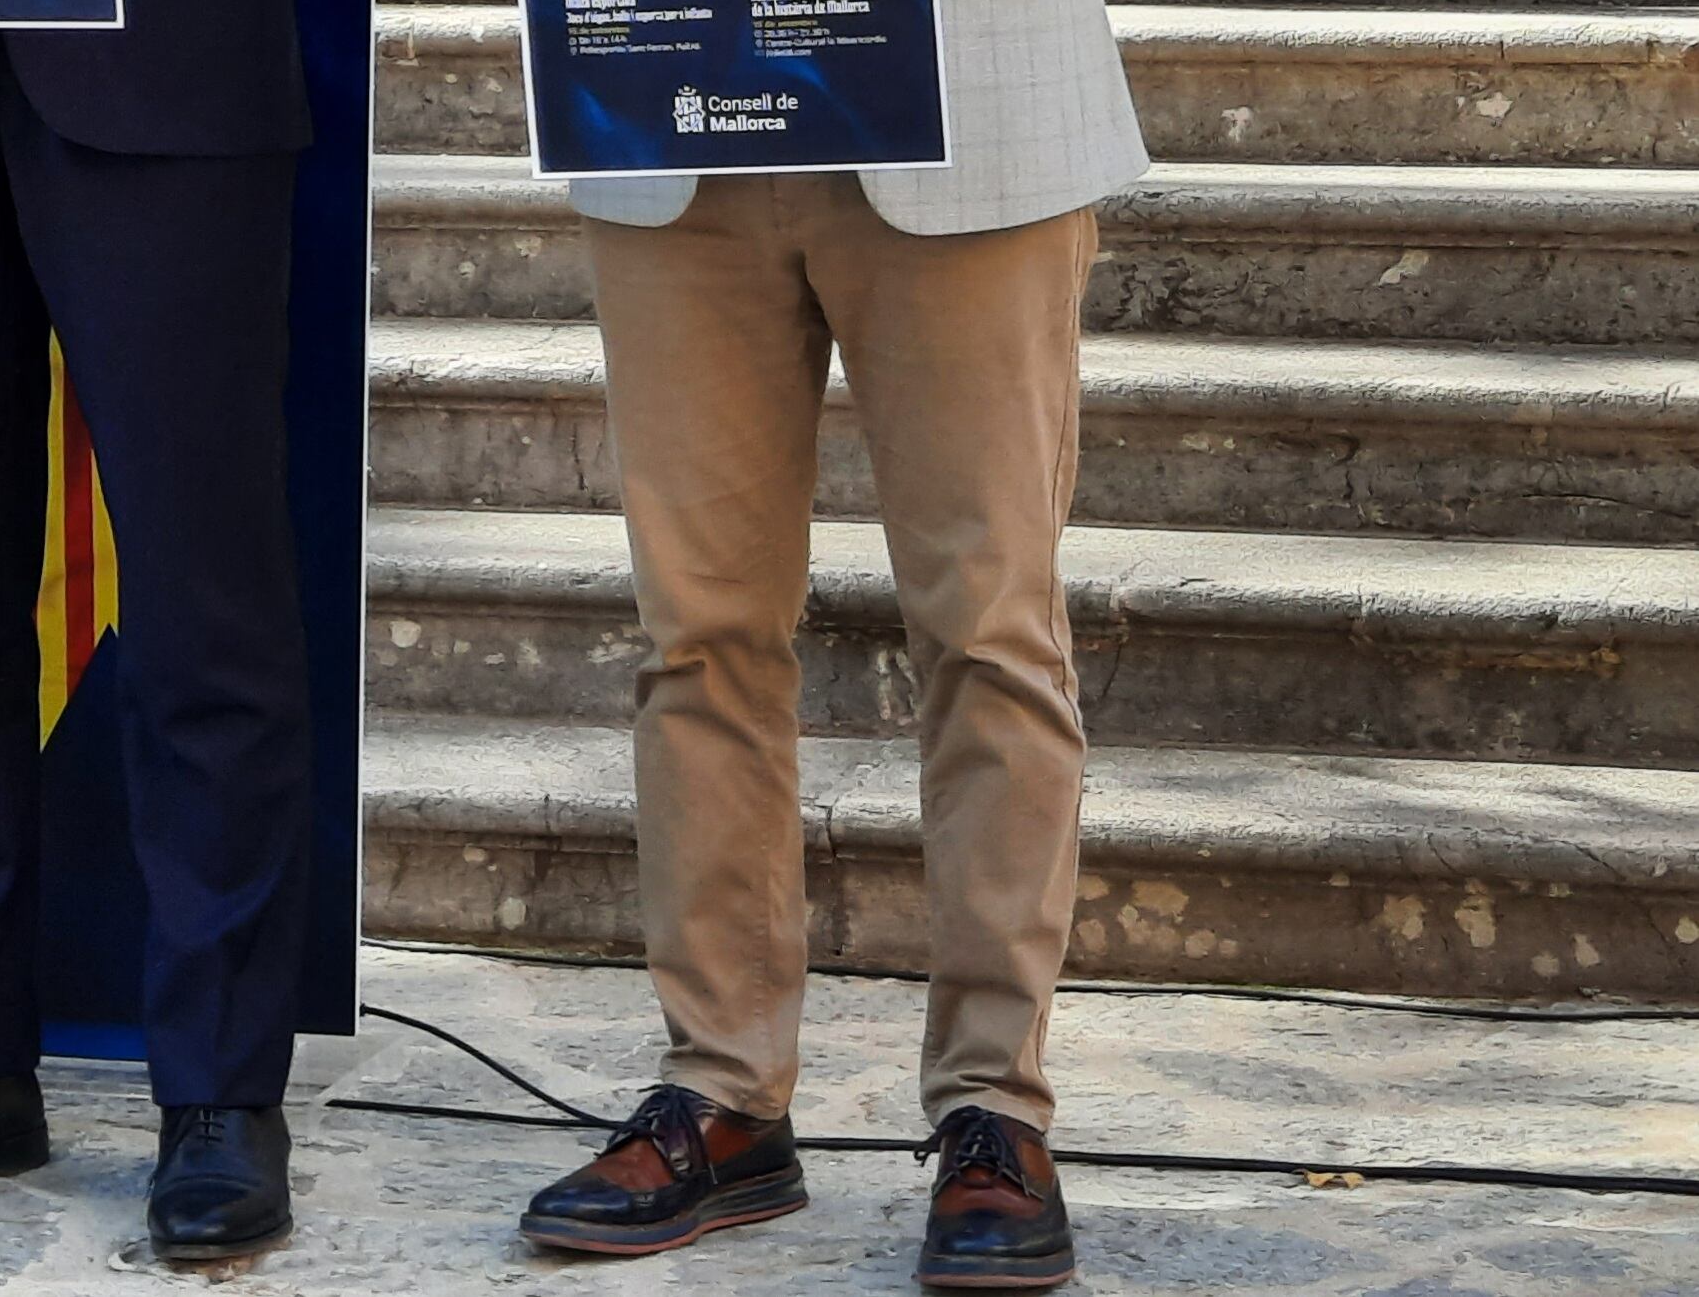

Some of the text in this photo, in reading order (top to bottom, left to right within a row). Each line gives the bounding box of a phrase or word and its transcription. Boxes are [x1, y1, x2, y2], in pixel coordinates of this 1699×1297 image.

[708, 93, 799, 112] Consell de
[710, 114, 786, 132] Mallorca
